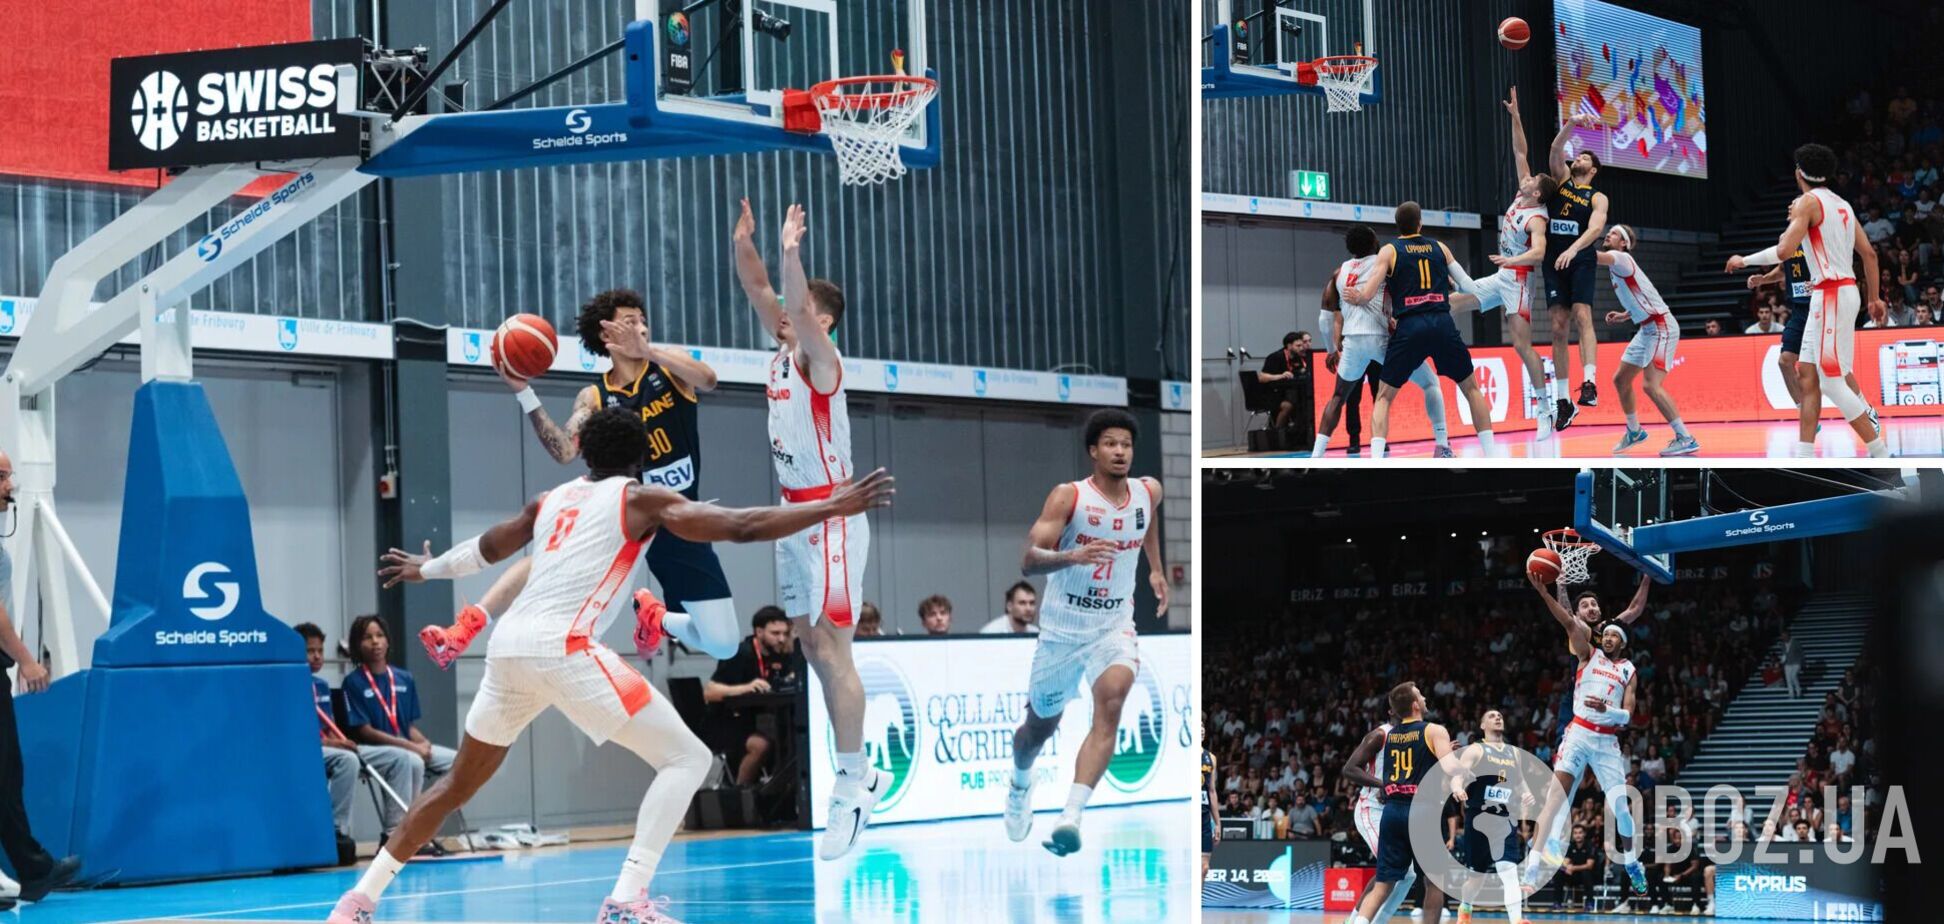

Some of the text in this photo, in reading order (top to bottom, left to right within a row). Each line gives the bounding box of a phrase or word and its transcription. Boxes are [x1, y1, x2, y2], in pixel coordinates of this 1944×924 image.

[670, 53, 689, 69] FIBA
[196, 63, 336, 116] SWISS
[197, 112, 336, 142] BASKETBALL
[533, 131, 628, 149] Schelde Sports
[271, 171, 314, 206] Sports
[1552, 222, 1576, 232] BGV
[1837, 208, 1849, 231] 7
[1418, 258, 1432, 289] 11
[1763, 522, 1796, 533] Sports
[1066, 593, 1124, 611] TISSOT
[155, 630, 267, 647] Schelde Sports
[1607, 684, 1616, 695] 7
[1390, 747, 1413, 782] 34
[961, 771, 985, 790] PUB
[1230, 869, 1249, 883] 14,
[1735, 875, 1807, 892] CYPRUS
